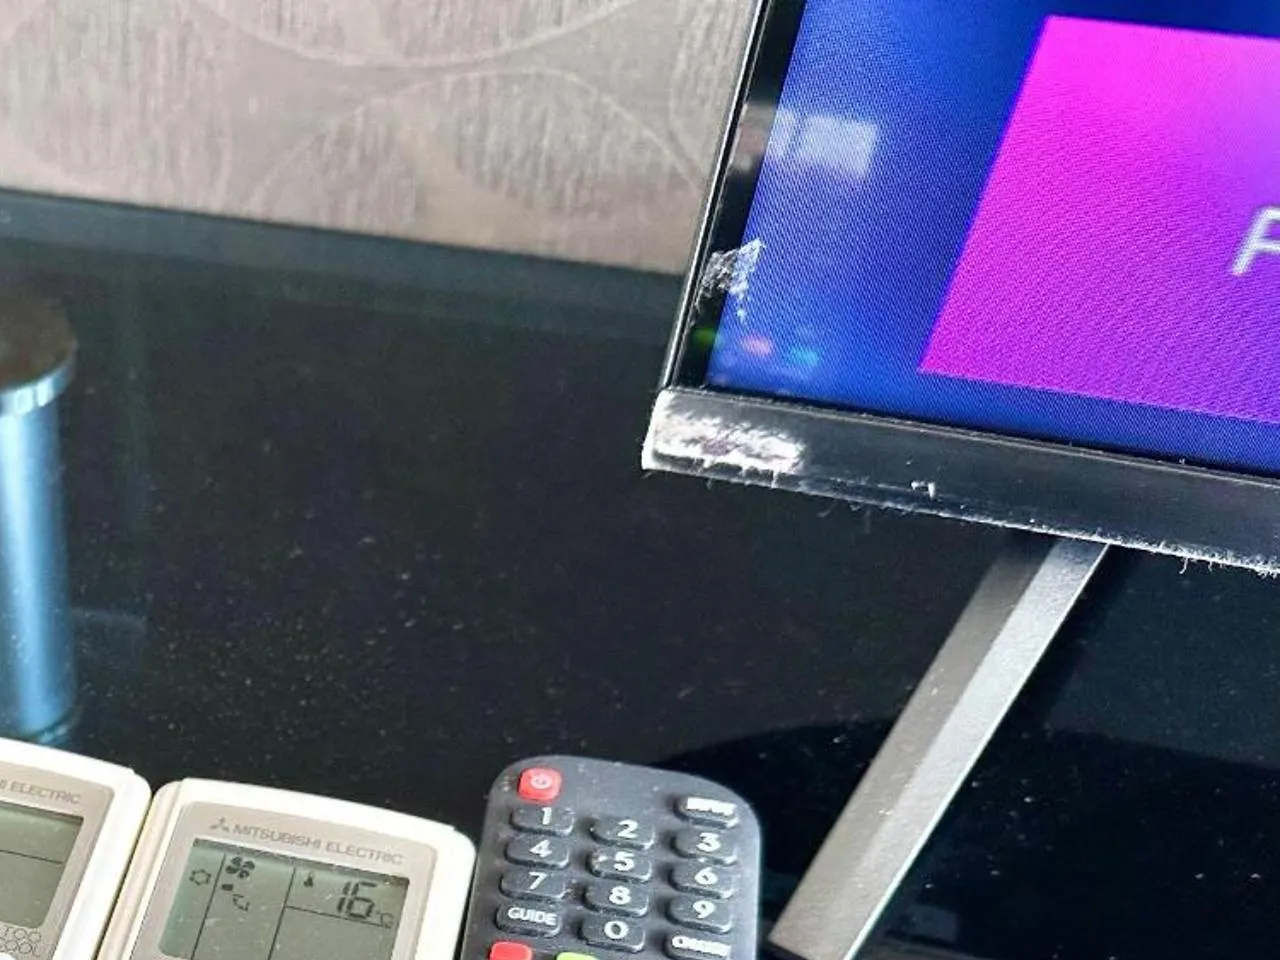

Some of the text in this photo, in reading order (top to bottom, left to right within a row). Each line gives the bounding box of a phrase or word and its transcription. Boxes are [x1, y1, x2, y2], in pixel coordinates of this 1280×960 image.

[9, 781, 82, 805] ELECTRIC
[541, 806, 553, 825] 1
[617, 819, 640, 839] 2
[232, 823, 405, 866] MITSUBISHI ELECTRIC
[529, 839, 553, 858] 4
[696, 832, 721, 852] 3
[613, 852, 636, 872] 5
[527, 871, 547, 890] 7
[694, 867, 718, 886] 6
[336, 880, 379, 920] 16
[608, 886, 632, 906] 8
[507, 907, 558, 926] GUIDE
[692, 900, 716, 919] 9
[4, 925, 43, 944] TOO
[604, 920, 628, 940] 0
